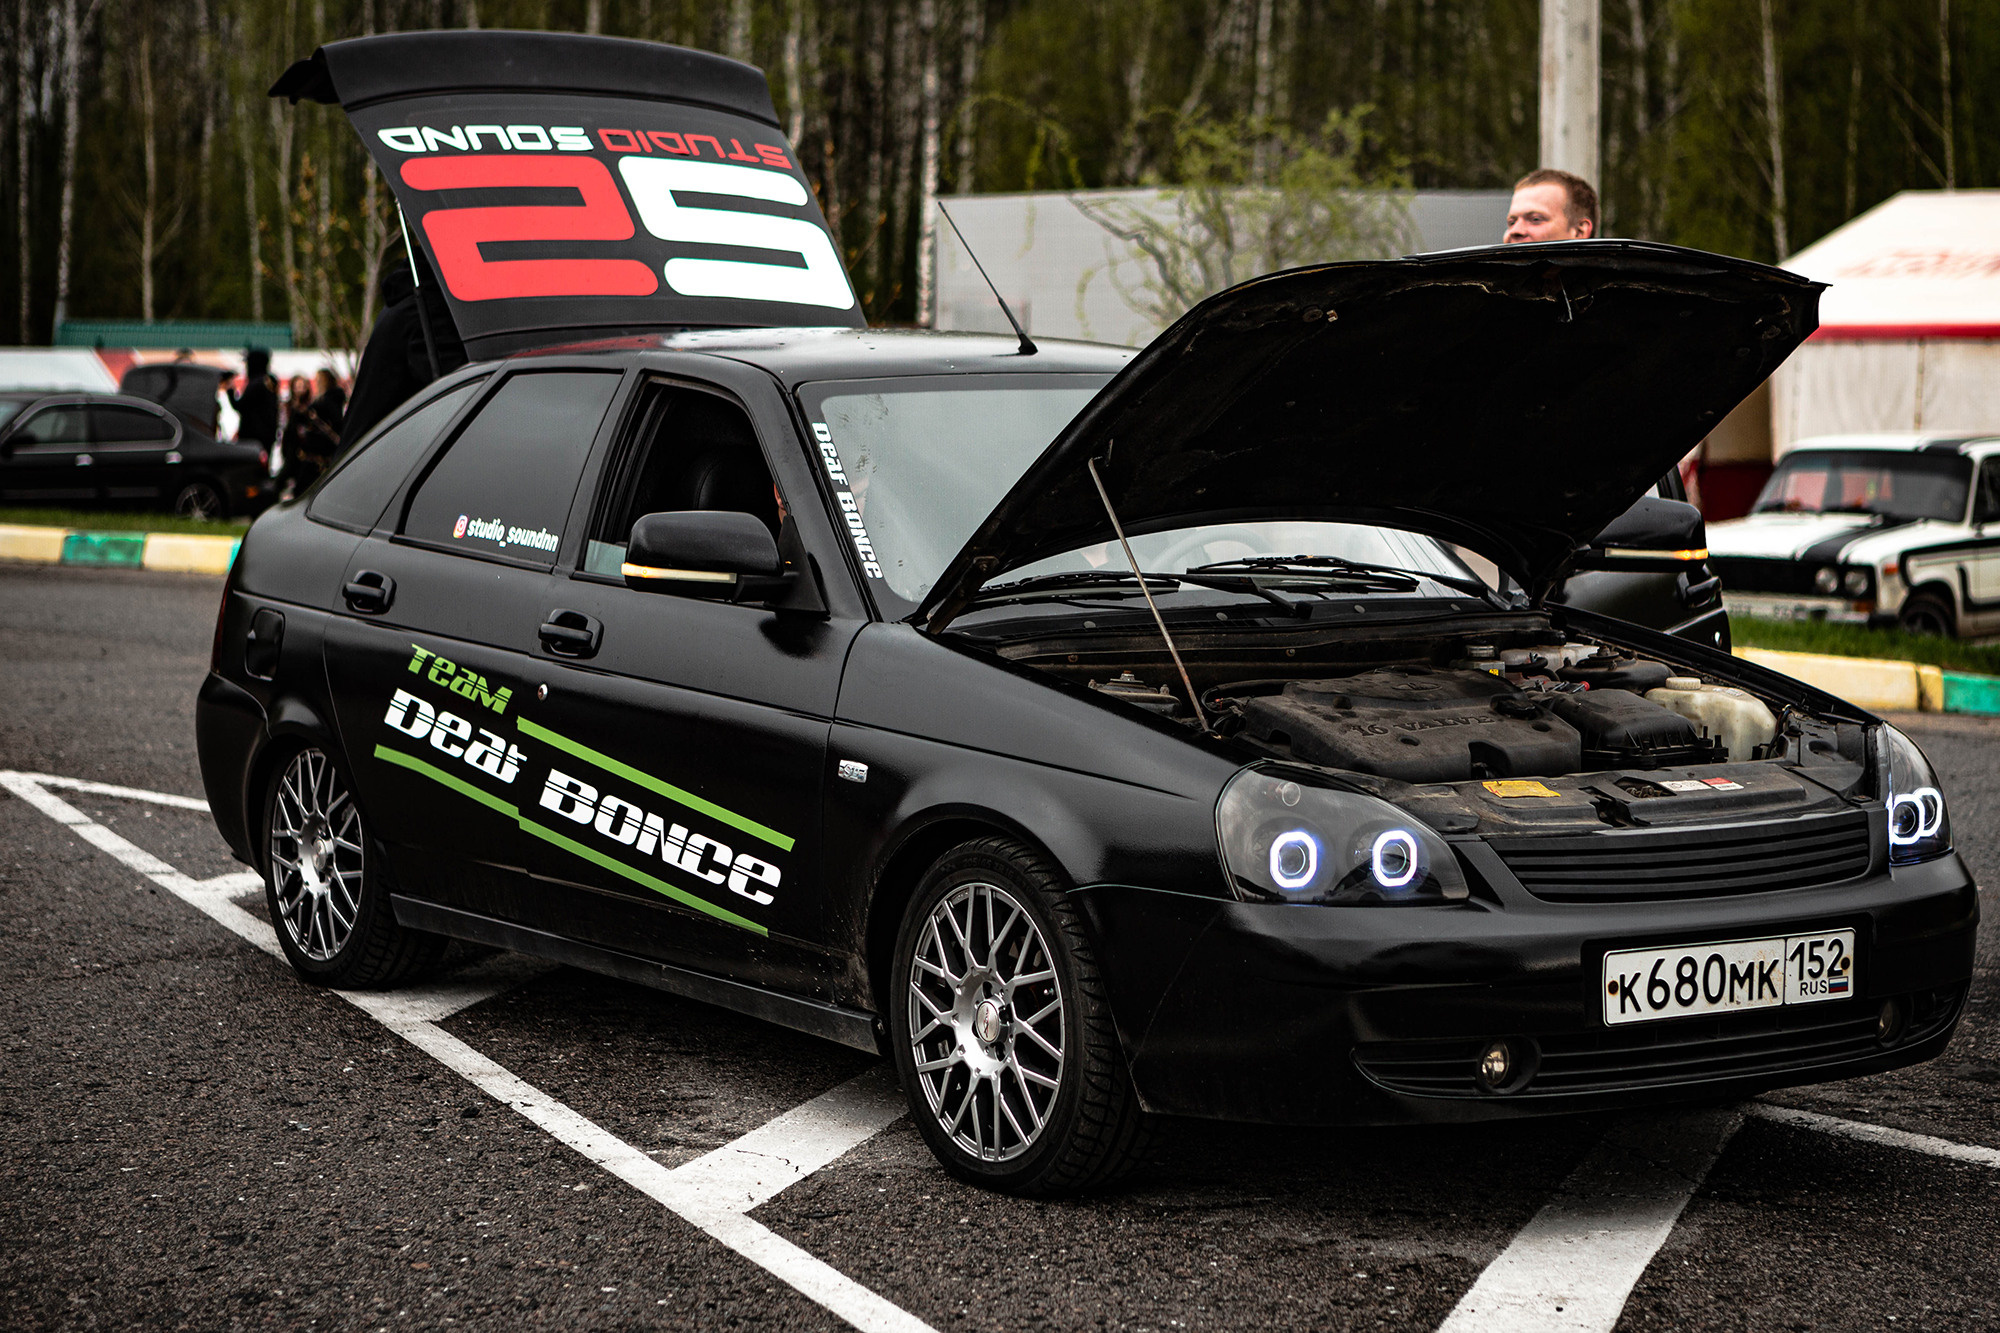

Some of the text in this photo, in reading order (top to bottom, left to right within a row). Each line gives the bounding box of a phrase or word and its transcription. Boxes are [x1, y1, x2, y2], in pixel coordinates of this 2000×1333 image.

[377, 125, 793, 170] STUDIO SOUND
[466, 516, 560, 553] studio_soundnn
[1392, 715, 1495, 732] VALVE
[1789, 938, 1845, 981] 152
[1799, 979, 1828, 996] RUS
